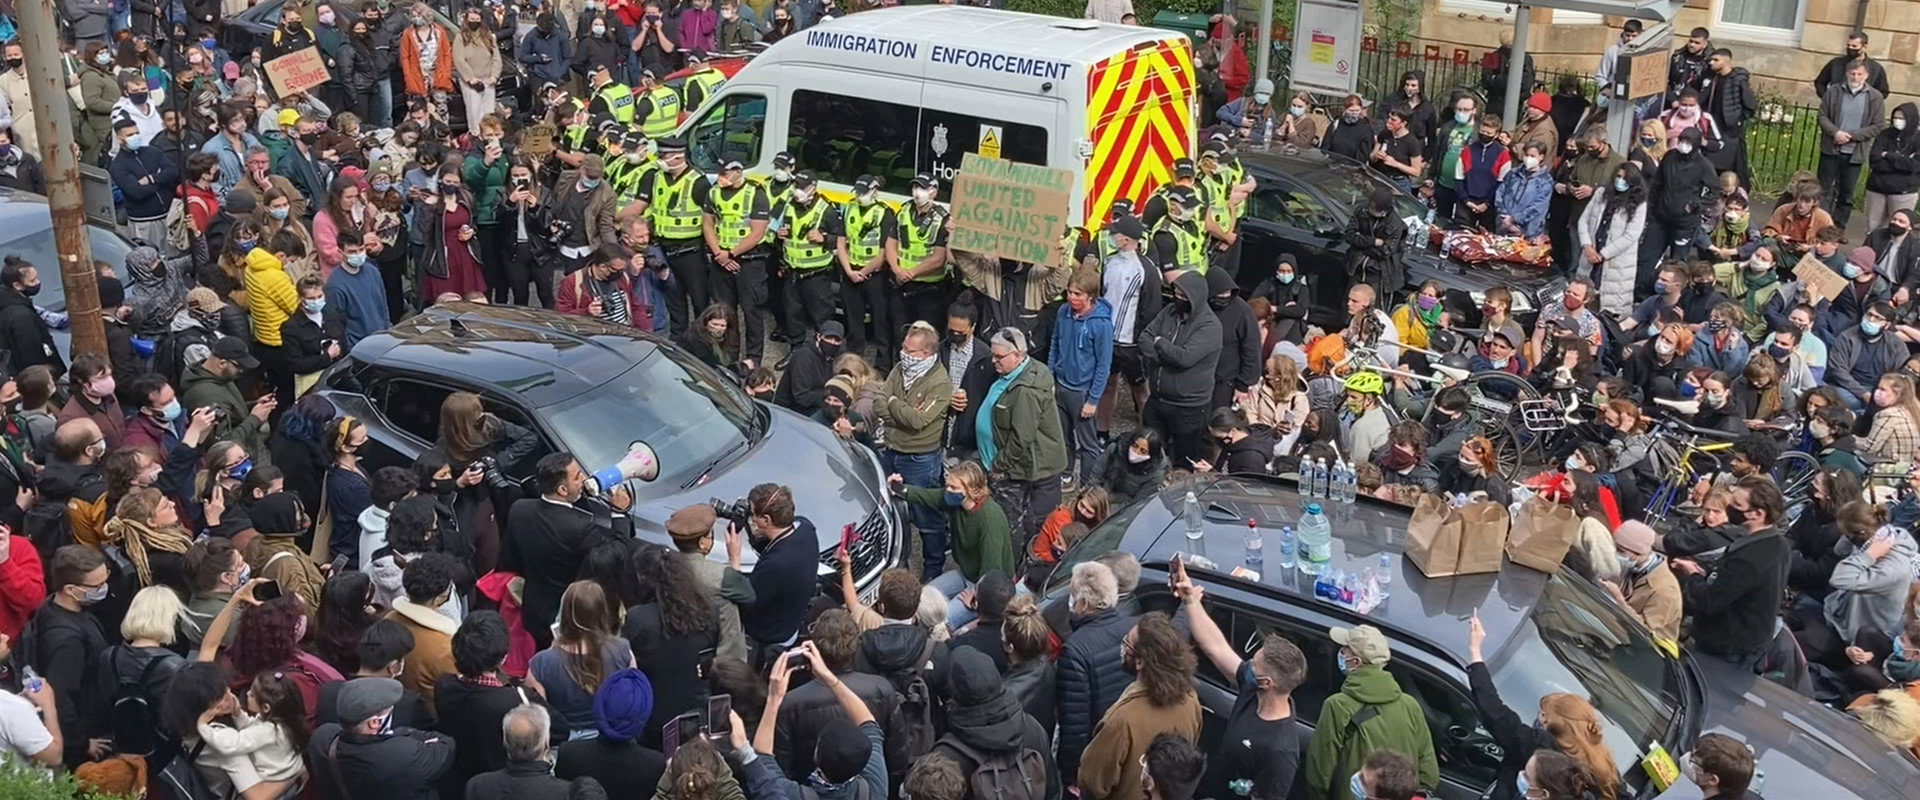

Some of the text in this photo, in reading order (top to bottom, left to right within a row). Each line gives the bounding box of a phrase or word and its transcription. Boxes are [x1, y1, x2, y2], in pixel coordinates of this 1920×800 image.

[806, 30, 1072, 81] IMMIGRATION ENFORCEMENT
[963, 179, 1036, 209] UNITED
[956, 200, 1059, 238] AGAINST
[954, 227, 1049, 263] EVICTION
